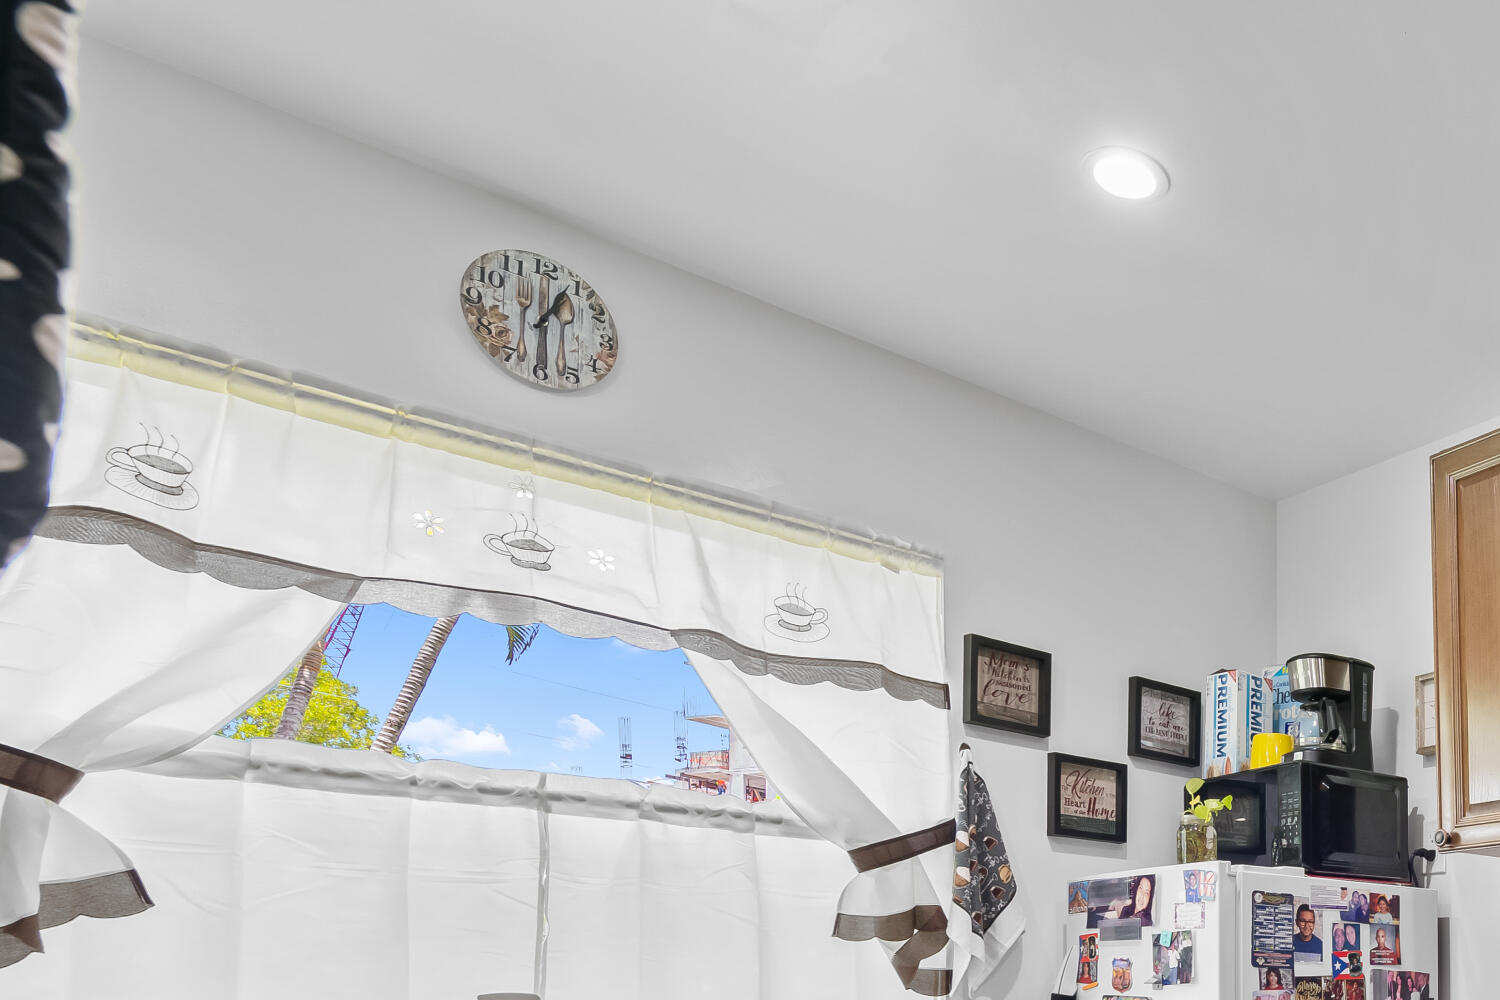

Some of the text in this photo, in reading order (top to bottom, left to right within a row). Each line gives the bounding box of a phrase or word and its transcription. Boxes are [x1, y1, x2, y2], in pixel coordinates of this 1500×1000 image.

[500, 254, 527, 278] 11
[530, 258, 559, 280] 12
[470, 266, 504, 289] 10
[465, 287, 482, 305] 9
[569, 280, 583, 298] 1
[588, 302, 606, 323] 2
[476, 317, 492, 336] 8
[600, 334, 613, 351] 3
[502, 345, 518, 362] 7
[533, 364, 548, 381] 6
[585, 355, 602, 373] 4
[565, 367, 580, 384] 5
[981, 678, 1032, 705] love
[1216, 673, 1229, 758] PREMIUM
[1250, 675, 1263, 742] PREMI
[1065, 768, 1105, 799] Kitchen
[1064, 797, 1086, 809] Heart
[1086, 796, 1117, 821] Home
